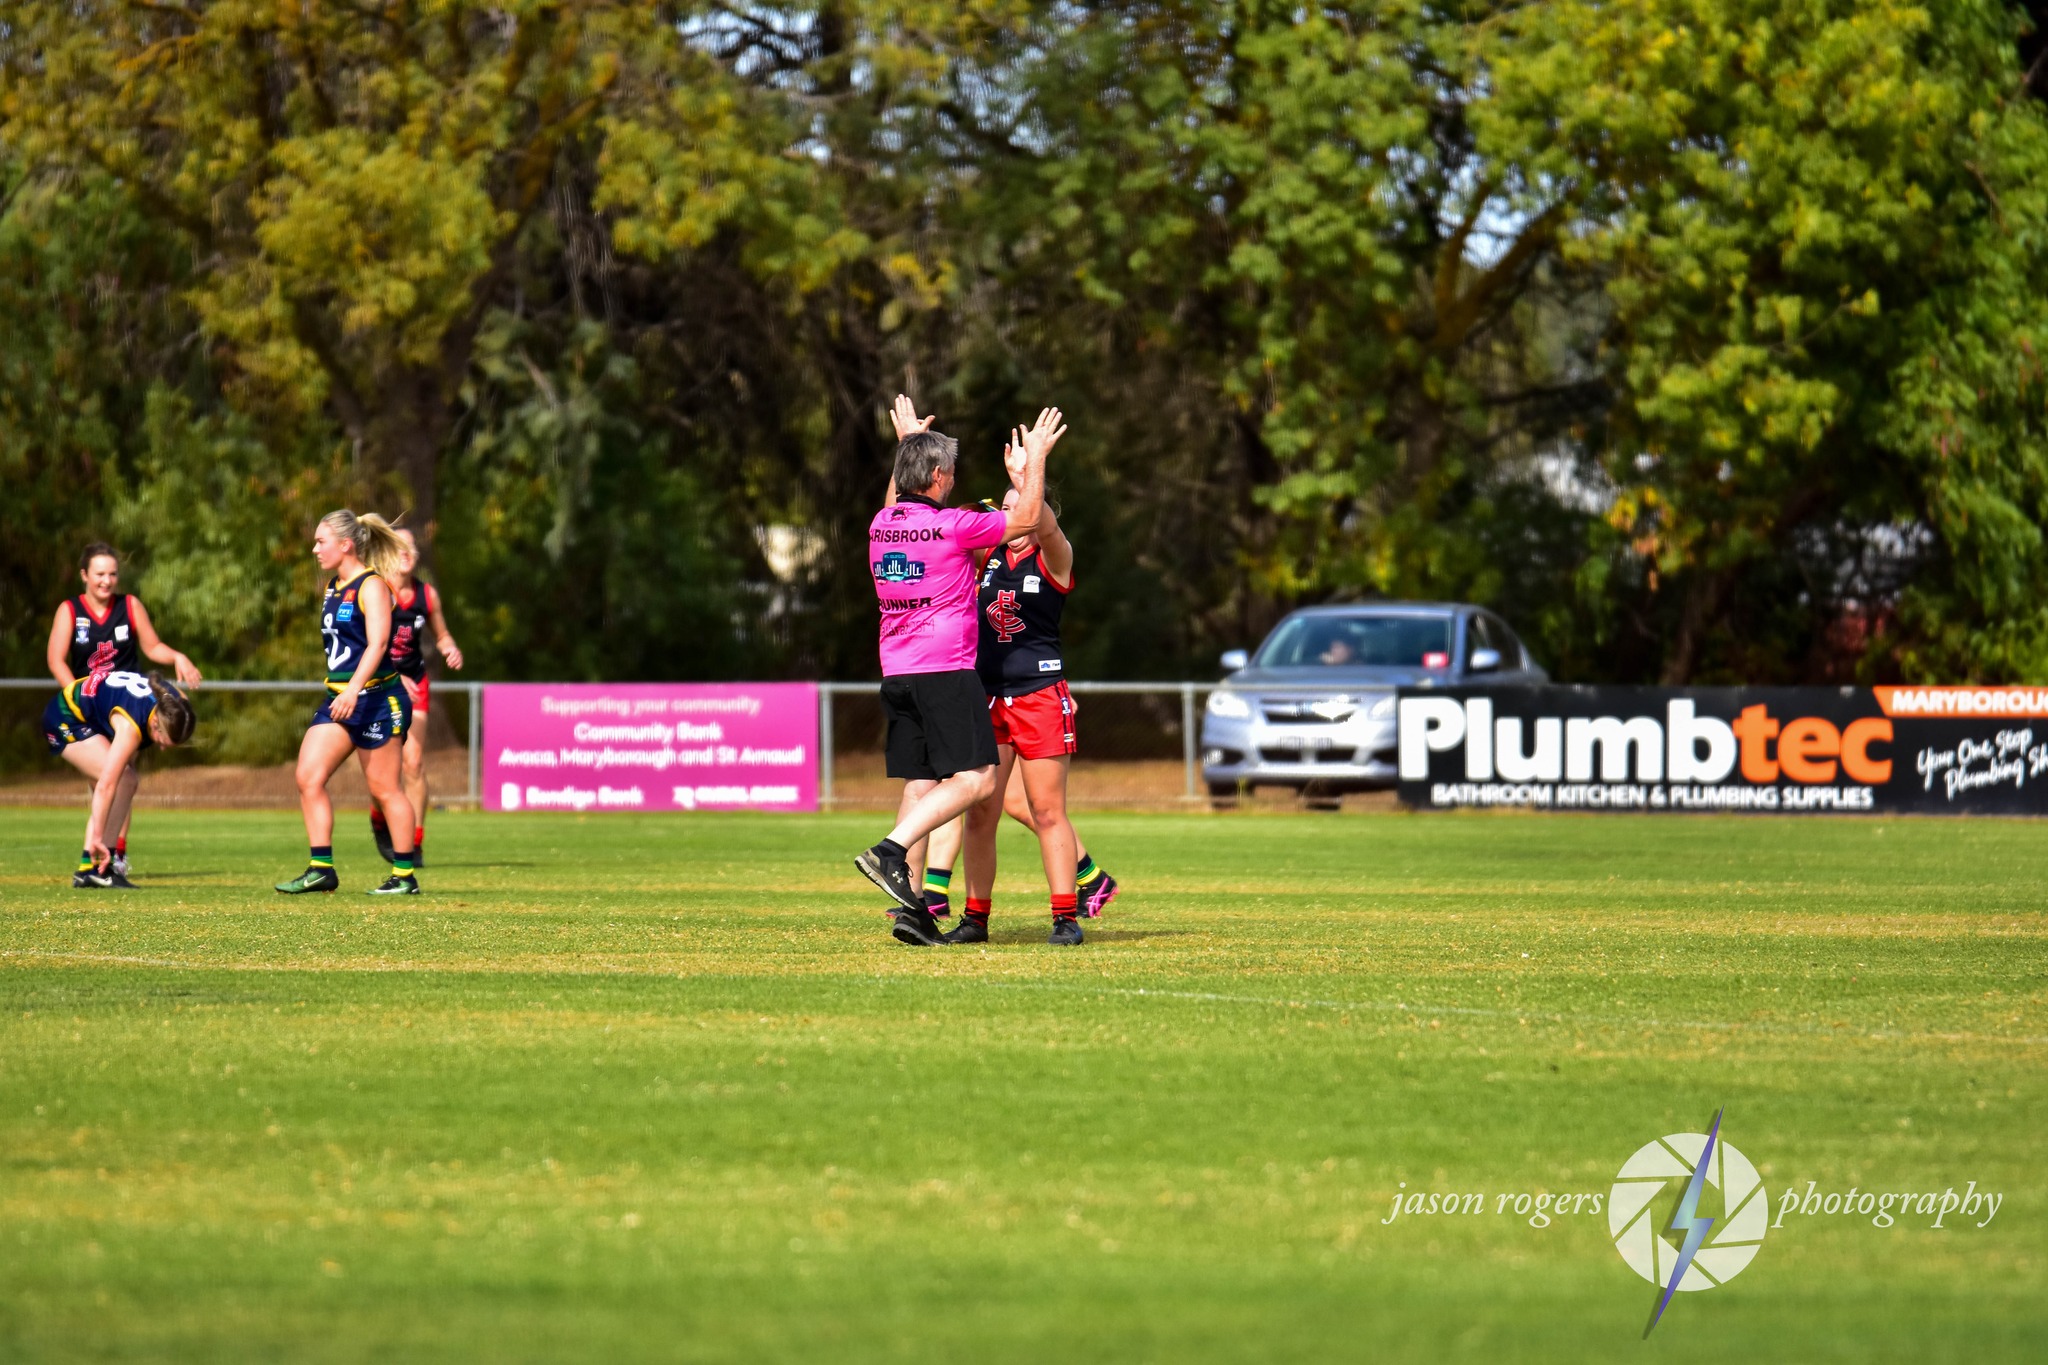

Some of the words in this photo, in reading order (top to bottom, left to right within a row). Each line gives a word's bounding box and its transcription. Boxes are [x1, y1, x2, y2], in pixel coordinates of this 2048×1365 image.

[105, 671, 152, 697] 8
[541, 696, 630, 717] Supporting
[634, 699, 667, 717] your
[671, 696, 762, 716] community
[574, 722, 673, 744] Community
[676, 722, 723, 742] Bank
[1398, 695, 1894, 784] Plumbtec
[560, 747, 676, 771] Maryborough
[678, 747, 713, 766] and
[739, 745, 805, 765] Arnaud
[1916, 746, 1956, 793] Your
[1958, 736, 1994, 766] One
[1995, 727, 2033, 761] Stop
[1944, 757, 2025, 802] Plumbing
[1432, 785, 1553, 805] BATHROOM
[1557, 785, 1646, 805] KITCHEN
[1649, 786, 1666, 805] &
[1670, 786, 1778, 807] PLUMBING
[1782, 786, 1874, 808] SUPPLIES
